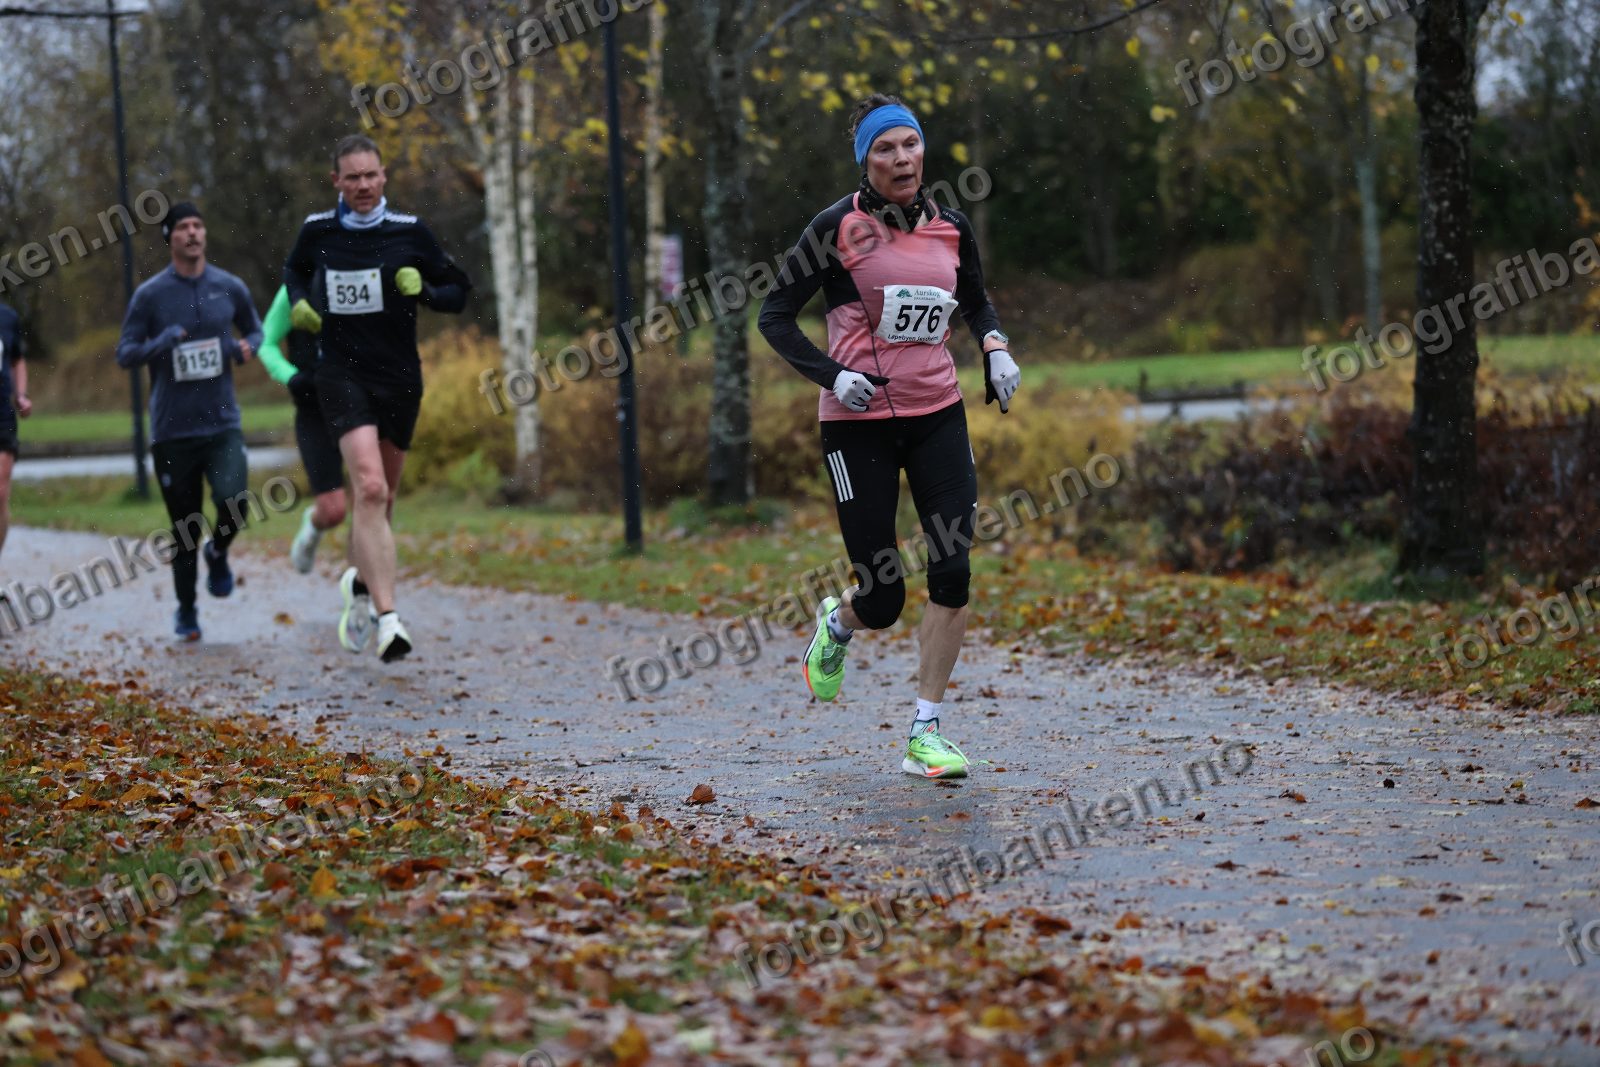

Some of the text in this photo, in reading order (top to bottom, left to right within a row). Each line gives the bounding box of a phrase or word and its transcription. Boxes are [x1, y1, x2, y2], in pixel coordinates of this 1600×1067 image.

[336, 284, 370, 305] 534
[895, 305, 943, 333] 576
[178, 349, 218, 372] 9152
